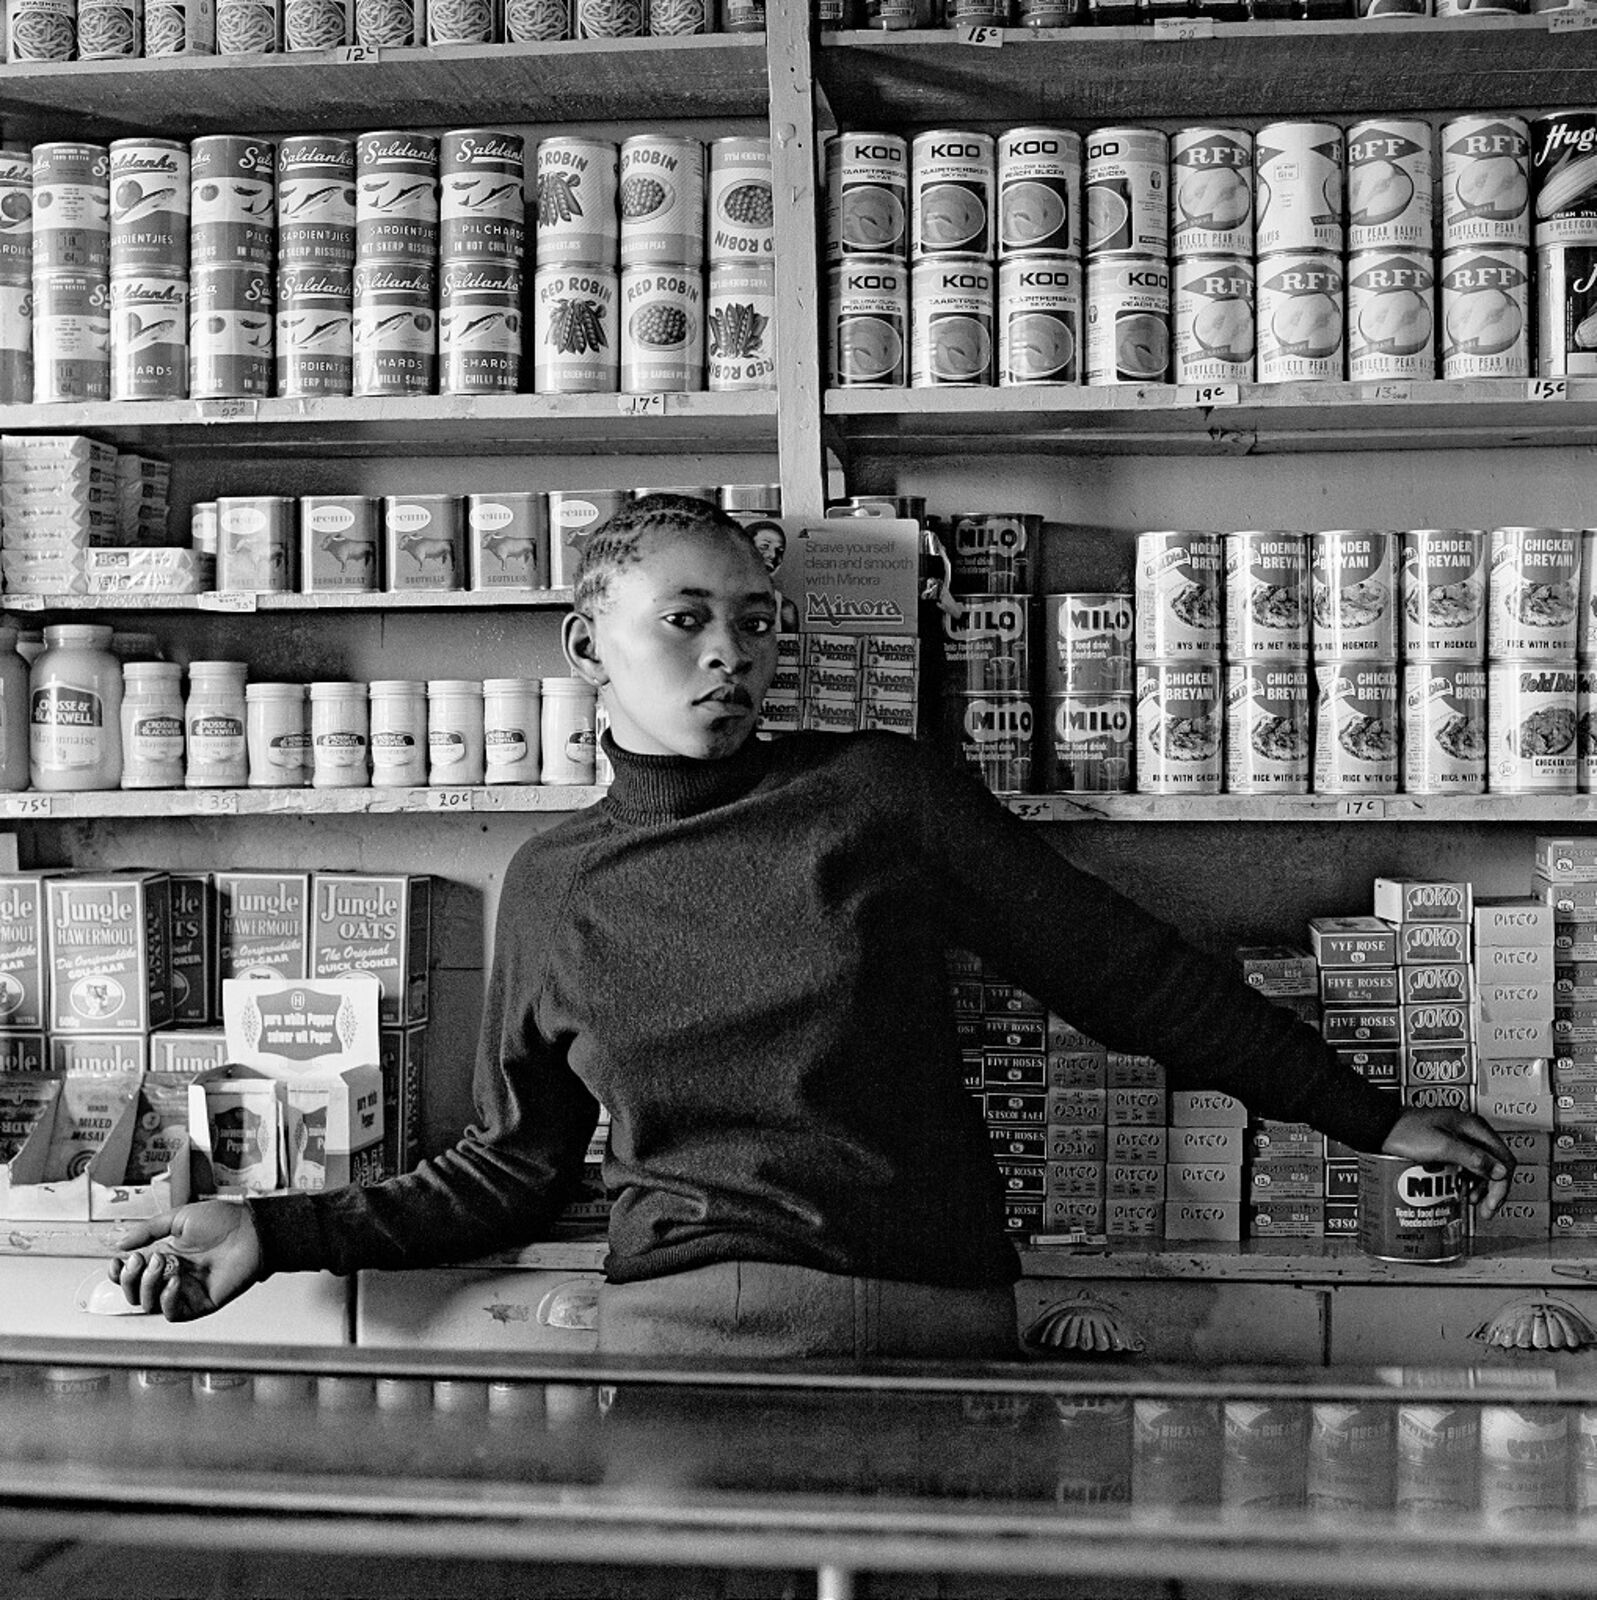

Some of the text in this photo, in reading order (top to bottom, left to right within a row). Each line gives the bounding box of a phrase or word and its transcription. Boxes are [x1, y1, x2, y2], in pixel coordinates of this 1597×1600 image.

[931, 144, 981, 159] KOO
[1009, 140, 1059, 157] KOO
[1465, 135, 1526, 155] RFF
[855, 145, 901, 162] KOO
[1187, 146, 1248, 166] RFF
[545, 151, 589, 173] ROBIN
[632, 150, 678, 173] ROBIN
[714, 230, 759, 253] ROBIN
[848, 275, 897, 291] KOO
[942, 274, 989, 291] KOO
[1019, 272, 1069, 287] KOO
[1128, 271, 1168, 289] KOO
[1280, 272, 1340, 292] RFF
[1366, 269, 1427, 289] RFF
[1452, 267, 1517, 289] RFF
[540, 277, 612, 303] RED ROBIN
[627, 276, 699, 303] RED ROBIN
[1196, 387, 1225, 402] 19c
[1534, 381, 1565, 399] 15c
[631, 397, 660, 411] 17c
[958, 528, 1018, 549] MILO
[1524, 539, 1574, 552] CHICKEN
[805, 541, 896, 555] Shave yourself
[805, 556, 914, 570] clean and smooth
[1524, 553, 1574, 567] BREYANI
[806, 572, 880, 586] with Minora
[806, 592, 902, 620] Minora
[950, 610, 1016, 631] MILO
[1071, 610, 1130, 630] MILO
[809, 639, 856, 653] Minora
[867, 639, 914, 653] Minora
[1527, 640, 1549, 649] WITH
[1165, 672, 1214, 685] CHICKEN
[1165, 687, 1214, 701] BREYANI
[972, 711, 1033, 731] MILO
[1063, 711, 1127, 731] MILO
[1171, 773, 1193, 782] WITH
[439, 792, 469, 807] 20c
[1345, 800, 1375, 815] 17c
[224, 880, 299, 918] Jungle
[320, 884, 398, 922] Jungle
[1412, 887, 1459, 907] JOKO
[56, 890, 133, 928] Jungle
[224, 919, 299, 936] HAWERMOUT
[1494, 913, 1538, 927] PITCO
[56, 927, 134, 945] HAWERMOUT
[339, 922, 397, 940] OATS
[1411, 928, 1457, 947] JOKO
[343, 943, 390, 961] Original
[1330, 940, 1386, 951] VYF ROSE
[317, 957, 399, 974] QUICK COOKER
[1494, 951, 1538, 966] PITCO
[1327, 977, 1394, 988] FIVE ROSES
[1413, 968, 1459, 990] JOKO
[1494, 989, 1538, 1001] PITCO
[1330, 1016, 1396, 1027] FIVE ROSES
[1414, 1007, 1460, 1028] JOKO
[1011, 1023, 1043, 1033] ROSES
[1494, 1027, 1538, 1041] PITCO
[1012, 1058, 1043, 1068] ROSES
[1416, 1060, 1461, 1080] JOKO
[1491, 1064, 1534, 1077] PITCO
[1116, 1093, 1159, 1107] PITCO
[1190, 1096, 1234, 1110] PITCO
[1414, 1087, 1461, 1108] JOKO
[1494, 1102, 1538, 1115] PITCO
[78, 1118, 113, 1129] MIXED
[1014, 1131, 1045, 1141] ROSES
[1116, 1133, 1160, 1146] PITCO
[1184, 1133, 1228, 1147] PITCO
[1055, 1165, 1098, 1179] PITCO
[1115, 1167, 1159, 1182] PITCO
[1182, 1168, 1226, 1182] PITCO
[1406, 1175, 1458, 1199] MIL
[1055, 1202, 1097, 1216] PITCO
[1114, 1205, 1157, 1219] PITCO
[1180, 1207, 1225, 1221] PITCO
